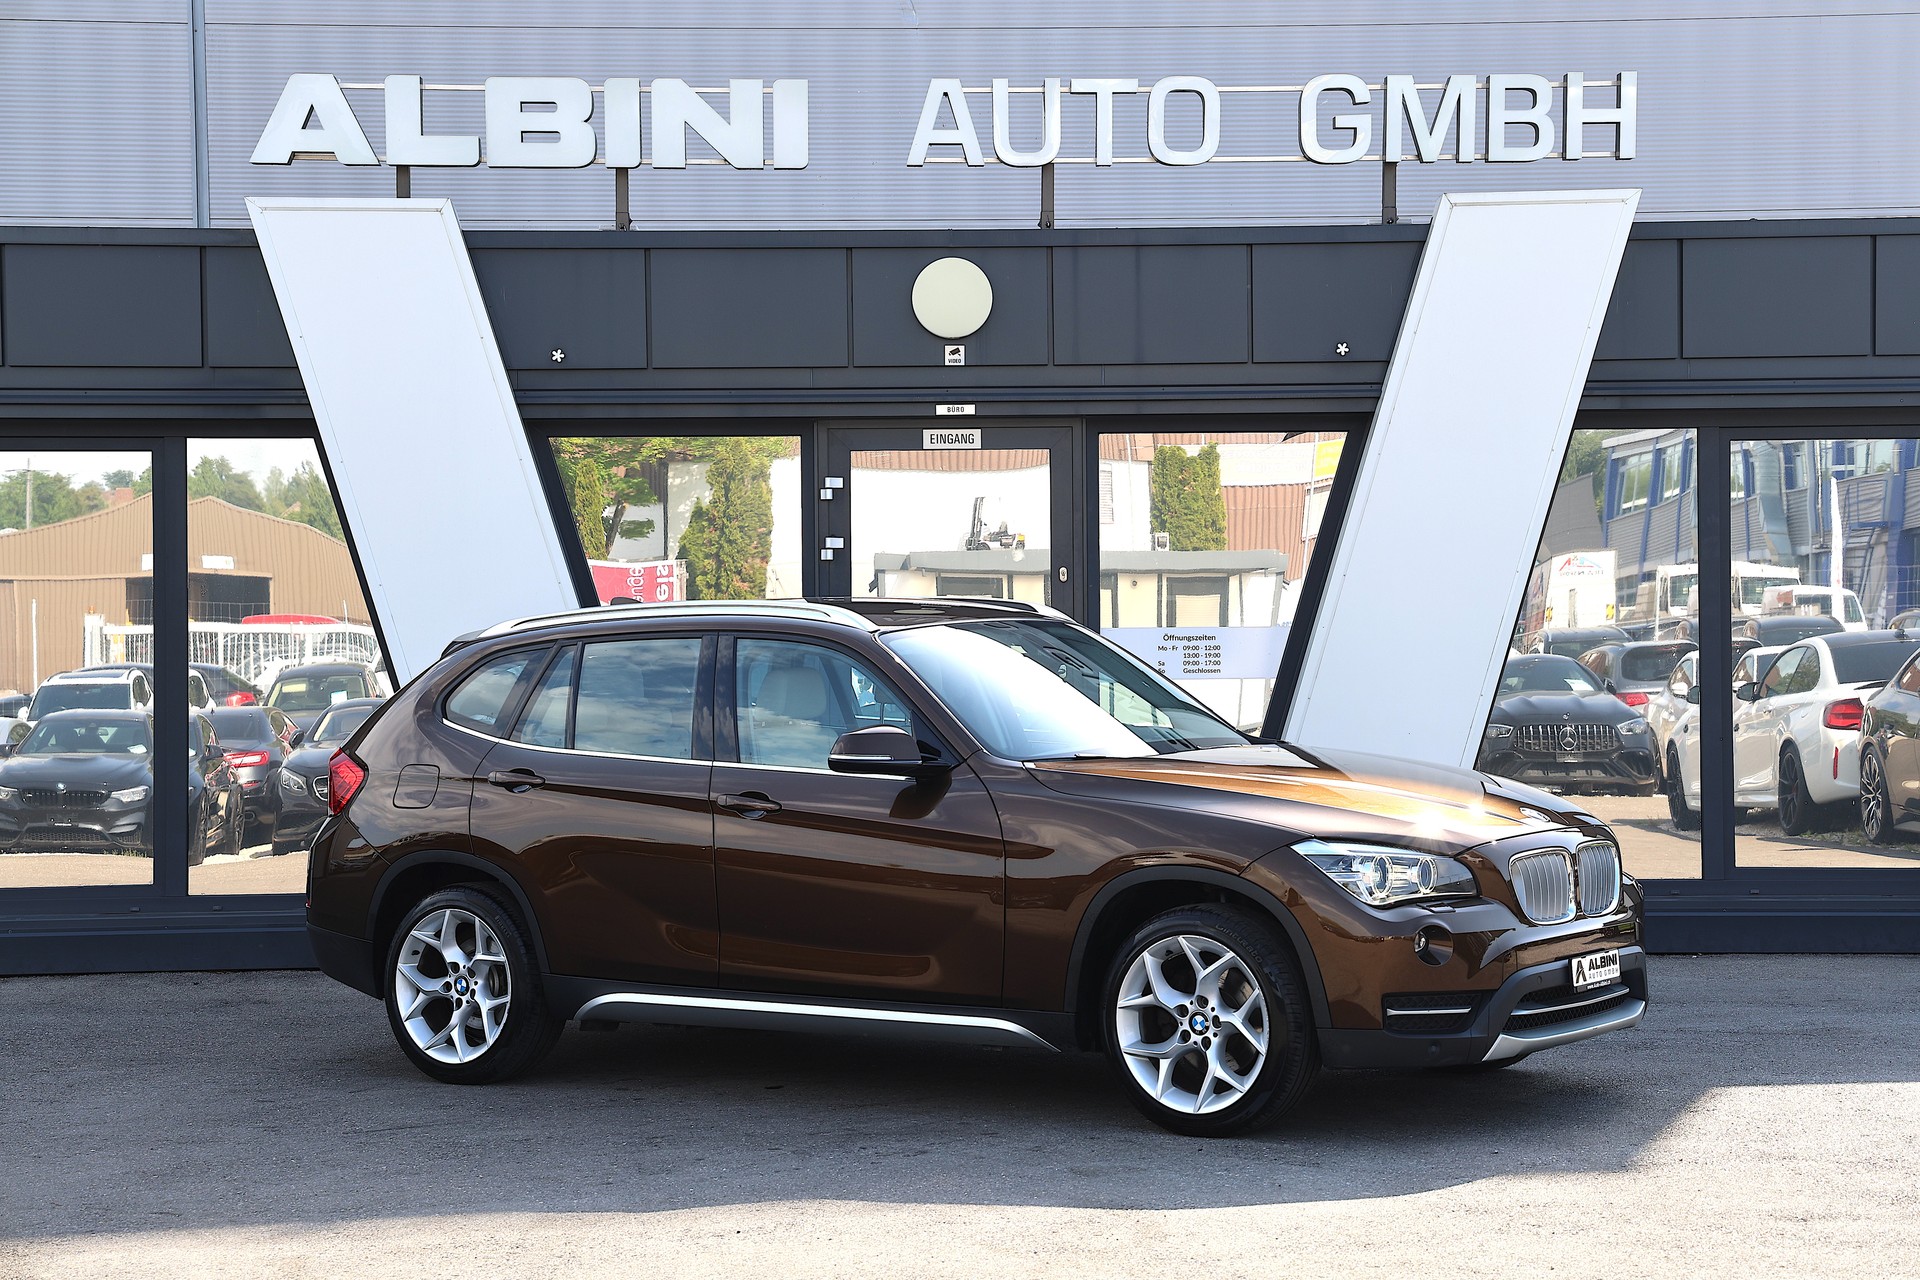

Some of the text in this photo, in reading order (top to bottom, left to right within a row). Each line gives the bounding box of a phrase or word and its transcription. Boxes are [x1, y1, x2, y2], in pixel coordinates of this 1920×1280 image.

[249, 71, 1638, 169] ALBINI AUTO GMBH
[930, 433, 975, 444] EINGANG
[1163, 633, 1216, 642] Öffnungszeiten
[1589, 953, 1618, 971] ALBINI
[1589, 971, 1602, 979] AUTO
